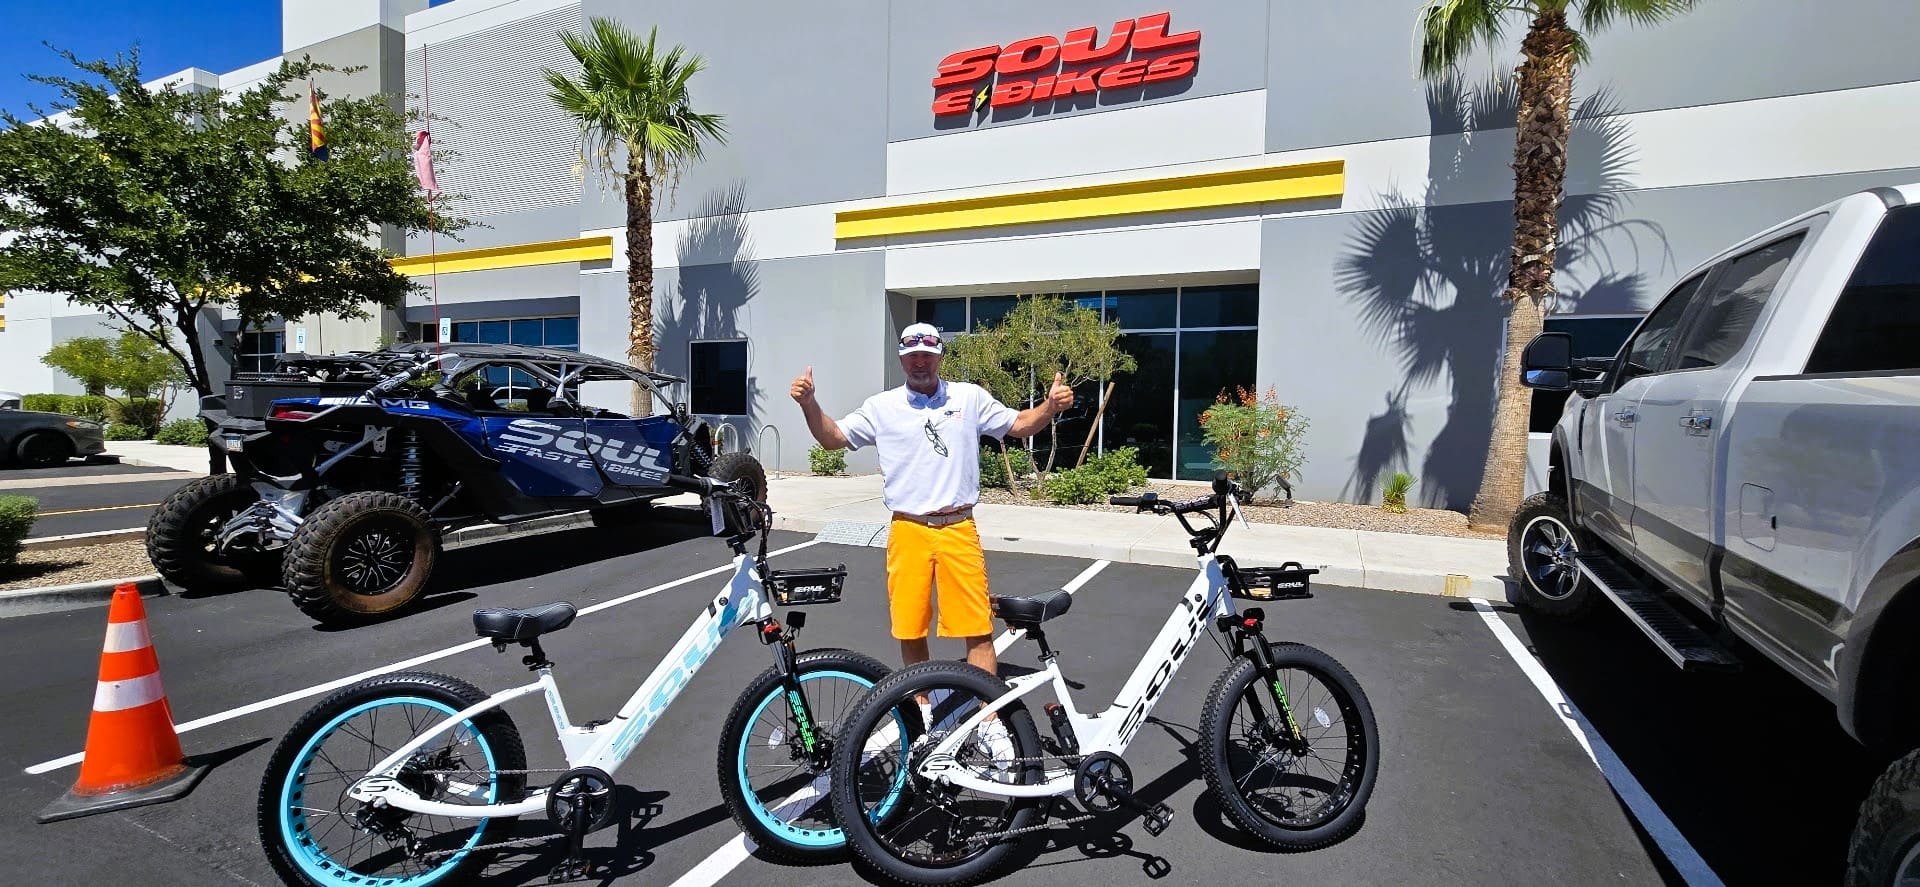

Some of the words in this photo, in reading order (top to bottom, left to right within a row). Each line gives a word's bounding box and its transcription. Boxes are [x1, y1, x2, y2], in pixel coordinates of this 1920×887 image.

[932, 11, 1201, 87] SOUL
[990, 50, 1200, 107] BIKES
[494, 442, 579, 464] FAST
[499, 418, 670, 473] SOUL
[1118, 588, 1223, 746] SOUL
